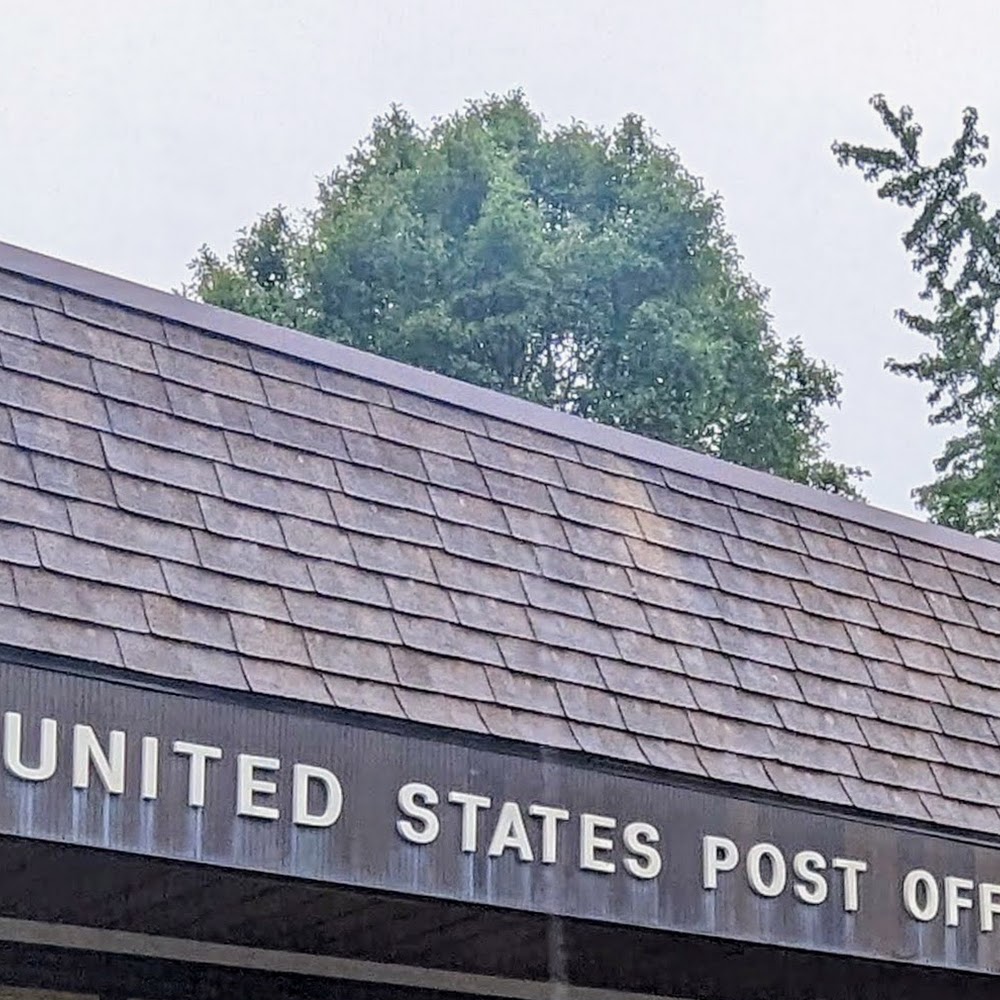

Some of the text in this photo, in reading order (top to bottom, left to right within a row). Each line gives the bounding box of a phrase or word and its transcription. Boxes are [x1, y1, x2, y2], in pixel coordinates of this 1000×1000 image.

[4, 711, 344, 828] UNITED
[396, 782, 663, 880] STATES
[702, 835, 868, 912] POST
